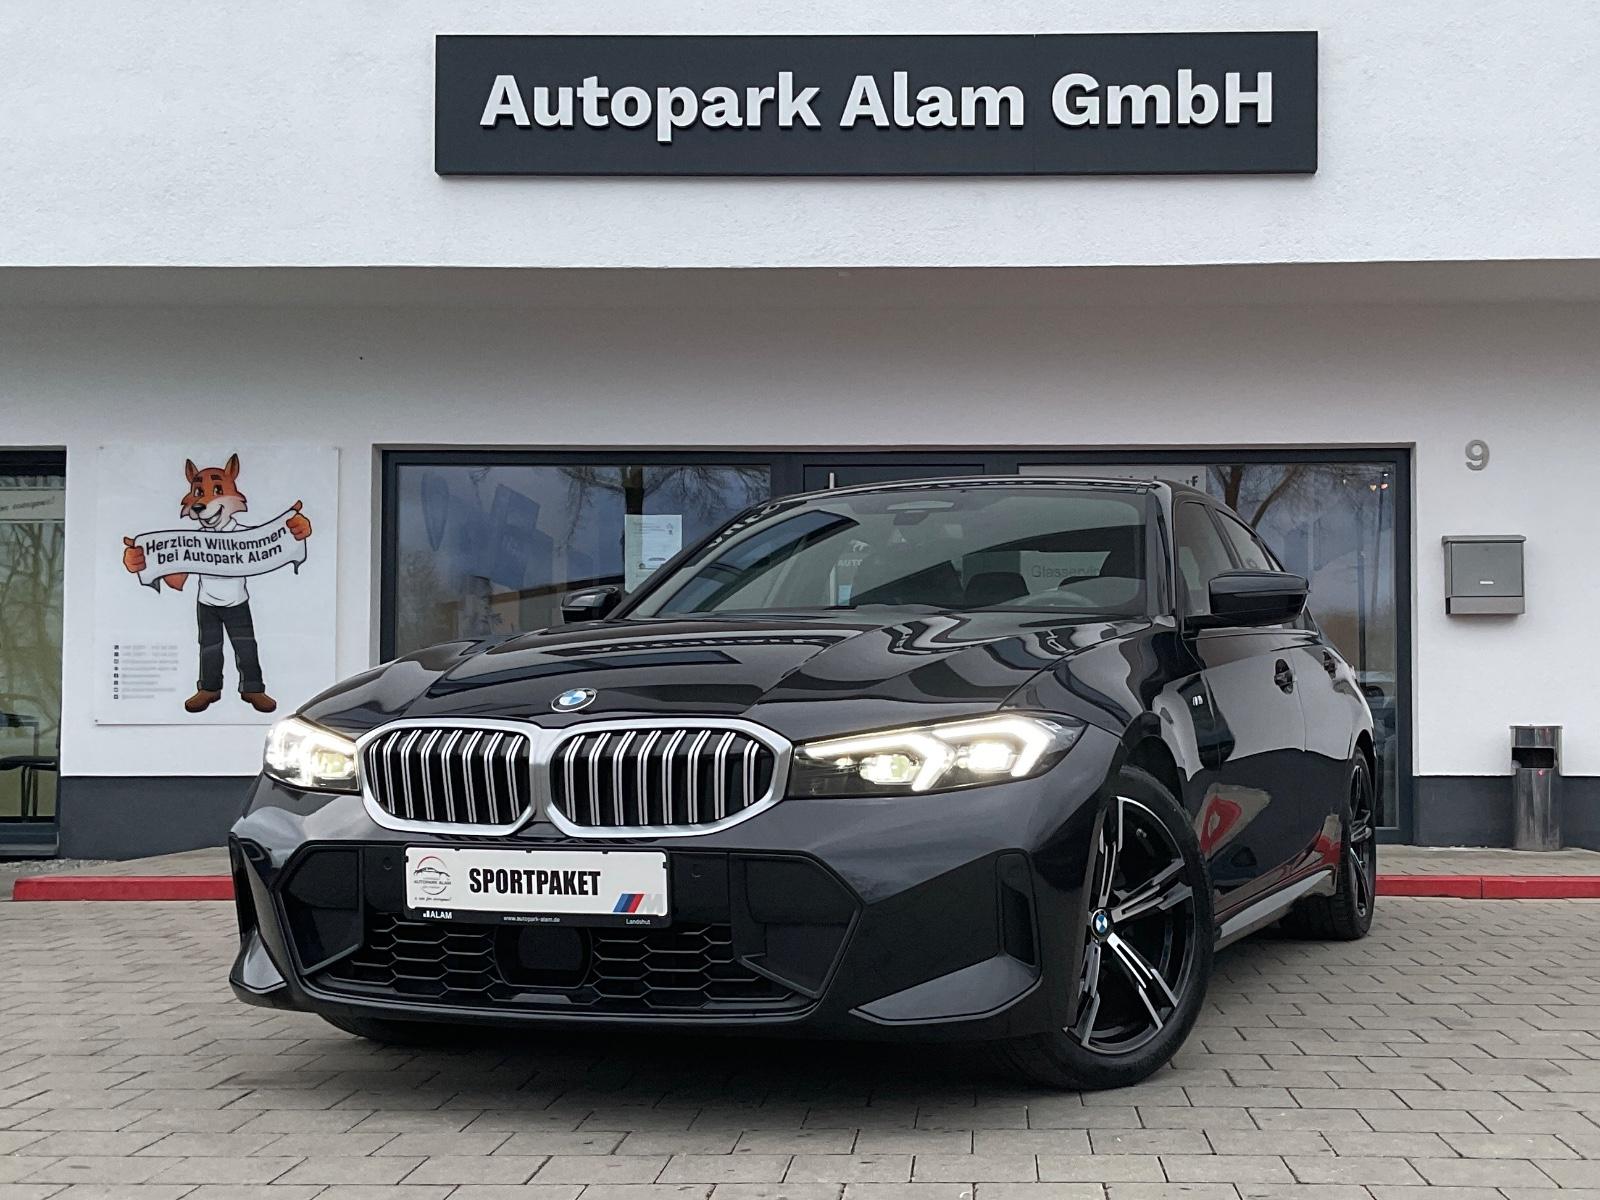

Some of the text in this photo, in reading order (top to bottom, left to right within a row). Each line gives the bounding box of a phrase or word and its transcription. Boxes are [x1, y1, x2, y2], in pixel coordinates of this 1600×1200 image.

[479, 69, 1273, 142] Autopark Alam GmbH
[1465, 440, 1490, 471] 9
[146, 527, 287, 555] Herzlich Willkommen
[158, 544, 283, 566] bei Autopark Alam
[469, 867, 601, 896] SPORTPAKET
[430, 910, 453, 920] ALAM
